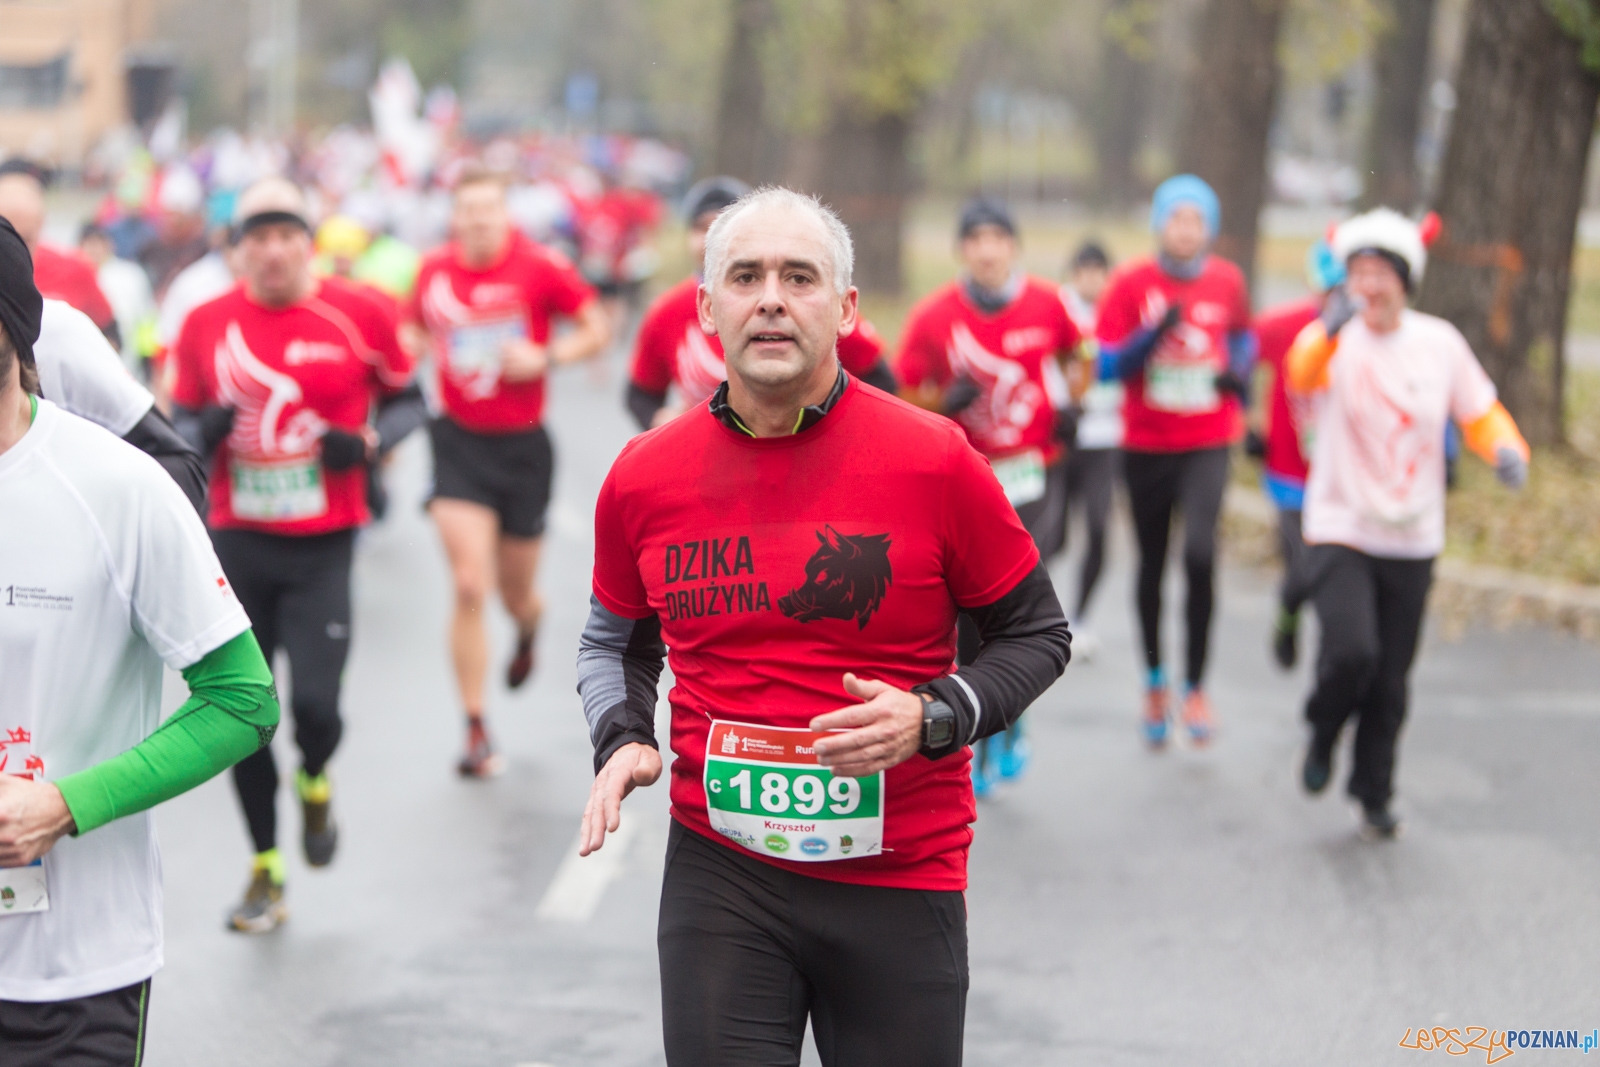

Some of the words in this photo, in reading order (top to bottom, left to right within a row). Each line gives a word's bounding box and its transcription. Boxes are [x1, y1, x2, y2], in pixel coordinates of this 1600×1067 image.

[664, 536, 754, 584] DZIKA
[665, 581, 771, 621] DRUŻYNA
[729, 769, 861, 815] 1899
[719, 827, 743, 838] GRUPA
[764, 820, 816, 832] Krzysztof
